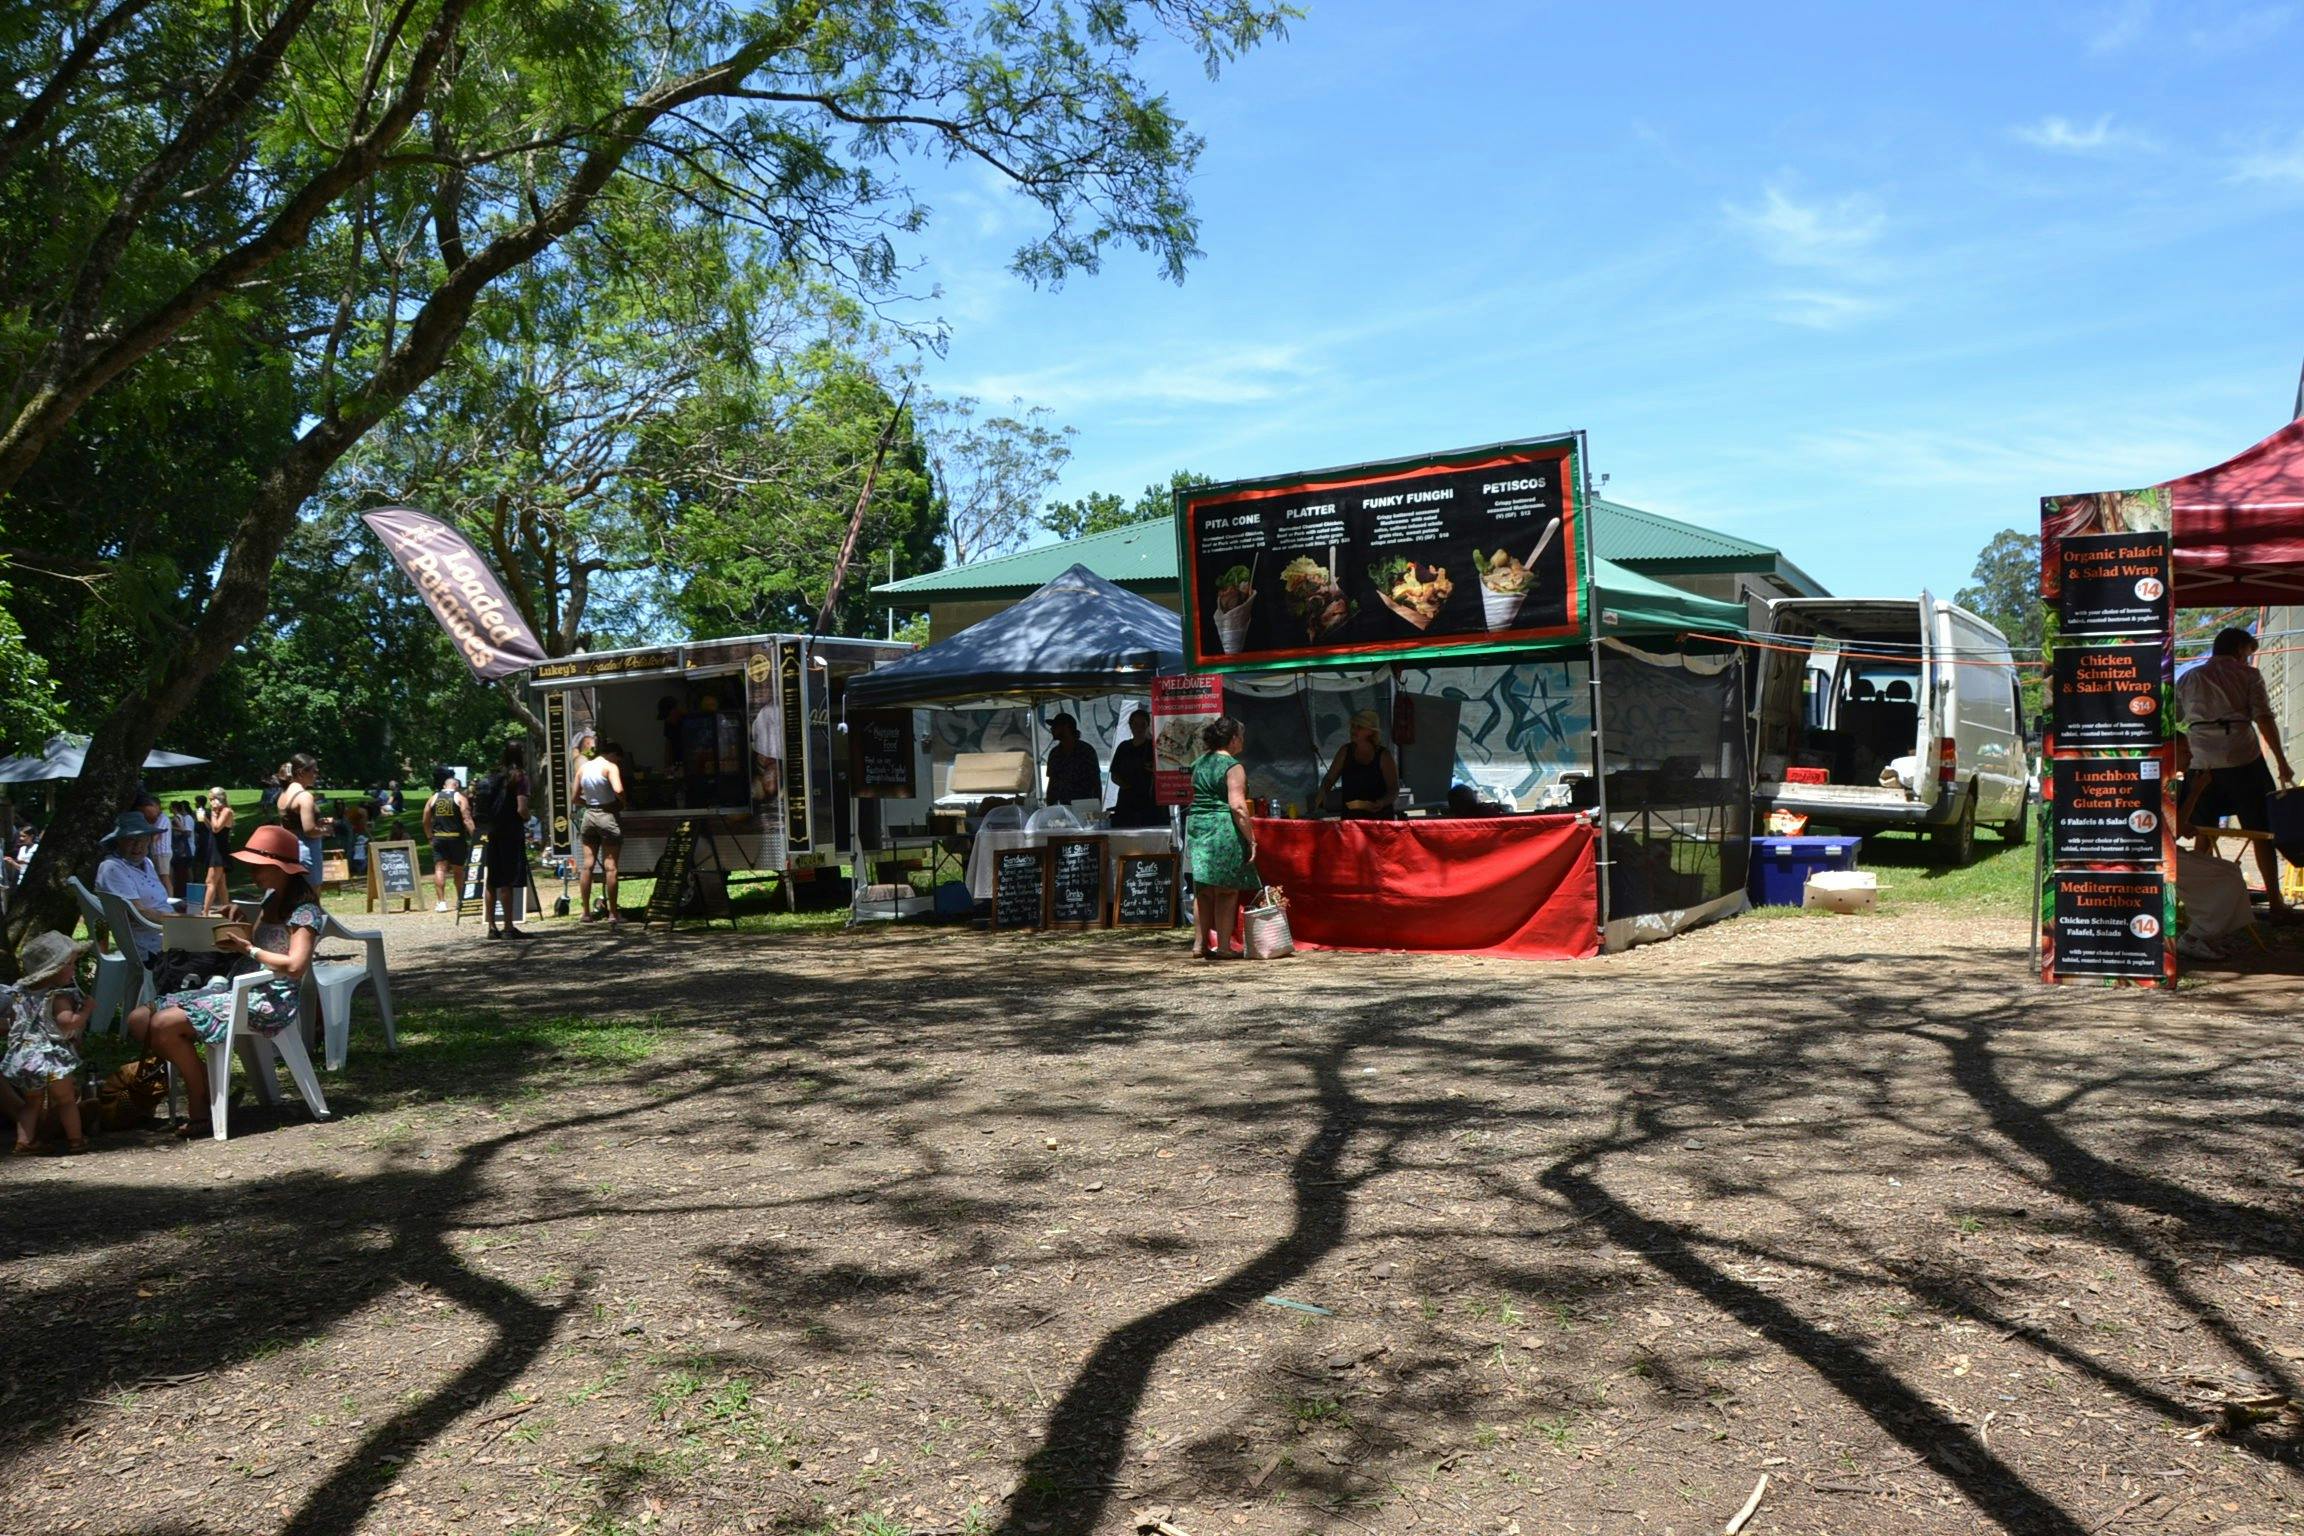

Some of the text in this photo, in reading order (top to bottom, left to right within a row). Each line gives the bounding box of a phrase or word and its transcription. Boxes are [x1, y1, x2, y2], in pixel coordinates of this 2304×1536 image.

[1483, 477, 1546, 494] PETISCOS
[1363, 488, 1454, 509] FUNKY FUNGHI
[1286, 503, 1336, 519] PLATTER
[1205, 513, 1261, 530] PITA CONE
[2064, 545, 2163, 563] Organic Falafel
[2068, 565, 2158, 579] & Salad Wrap
[2137, 582, 2160, 597] $14
[440, 548, 522, 647] Loaded
[407, 551, 495, 668] Potatoes
[2080, 655, 2132, 666] Chicken
[538, 663, 577, 677] Lukey's
[2077, 667, 2136, 679] Schnitzel
[2063, 681, 2151, 694] & Salad Wrap
[2075, 770, 2139, 781] Lunchbox
[2082, 785, 2133, 797] Vegan or
[2073, 798, 2141, 808] Gluten Free
[2106, 817, 2127, 825] Salad
[2130, 814, 2154, 830] $14
[2061, 882, 2158, 894] Mediterranean
[2077, 895, 2141, 907] Lunchbox
[2059, 916, 2090, 925] Chicken
[2131, 919, 2155, 934] $14
[2067, 928, 2095, 937] Falafel,
